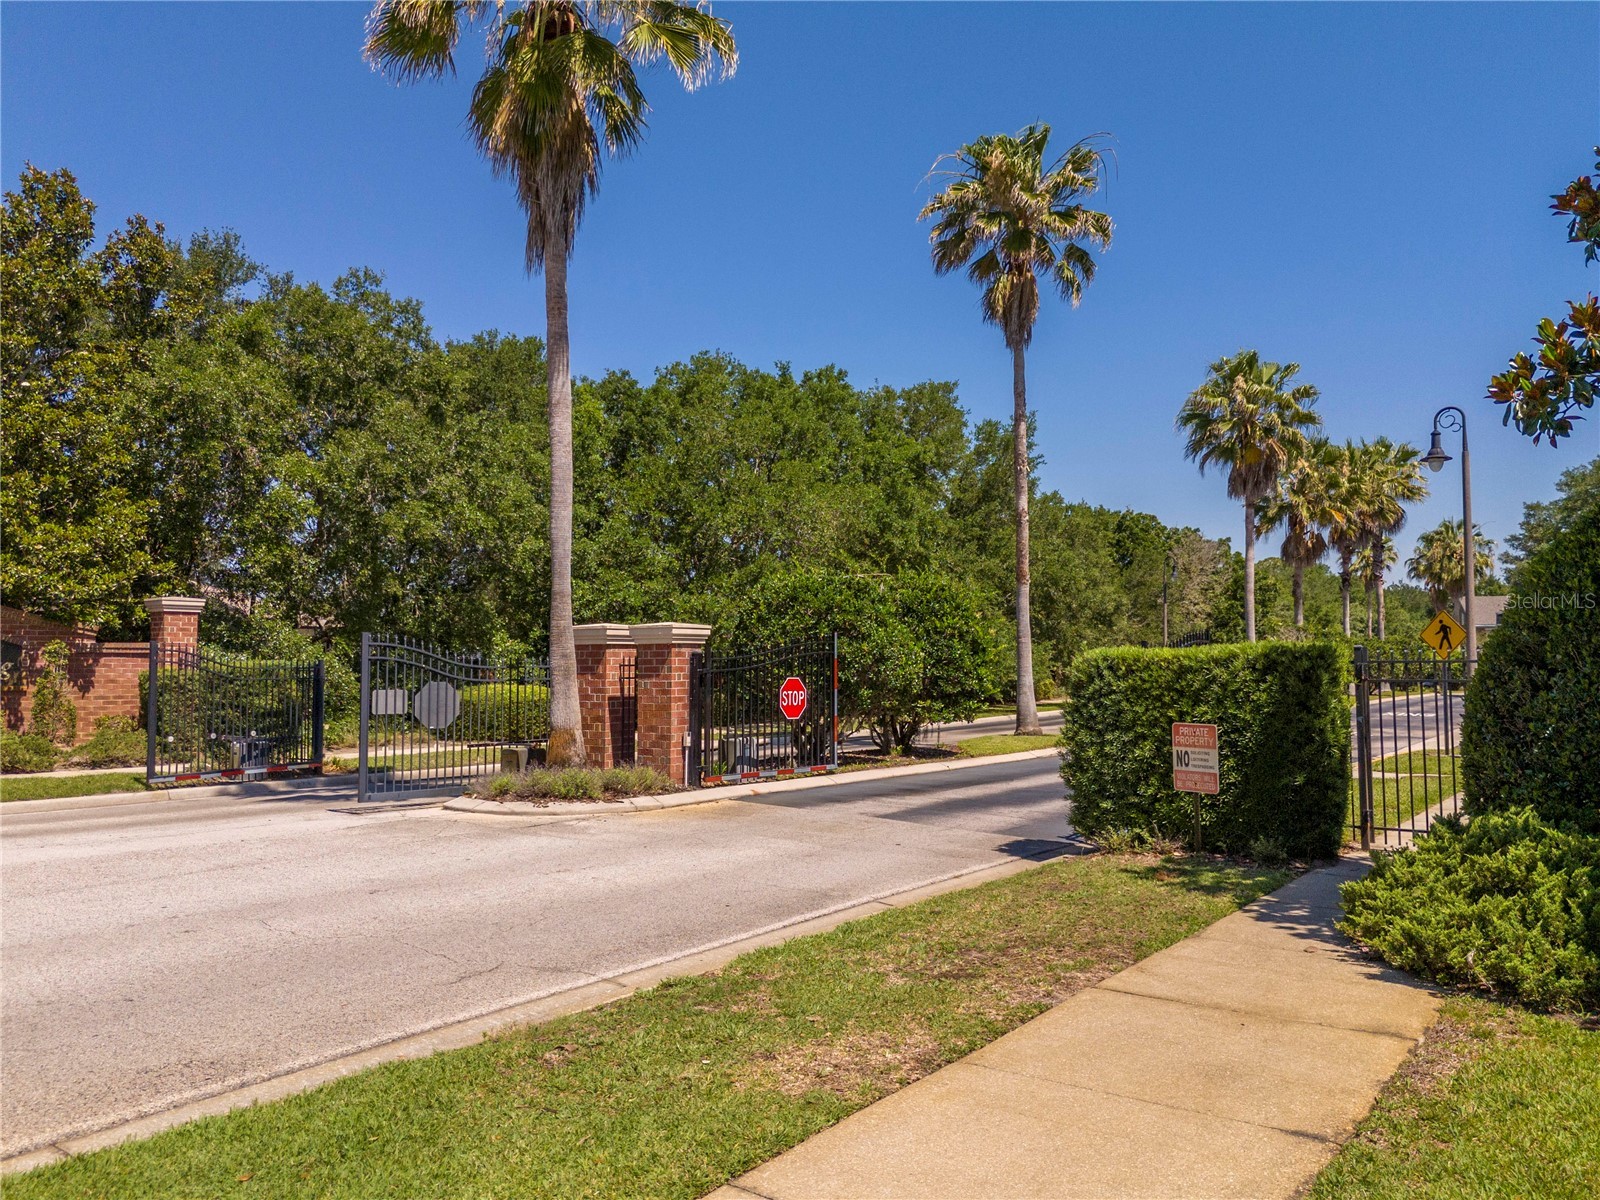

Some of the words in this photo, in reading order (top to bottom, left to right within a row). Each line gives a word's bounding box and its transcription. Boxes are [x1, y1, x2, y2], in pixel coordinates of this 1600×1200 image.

[782, 690, 805, 706] STOP
[1179, 726, 1209, 737] PRIVATE
[1175, 735, 1215, 747] PROPERTY
[1176, 749, 1190, 767] NO
